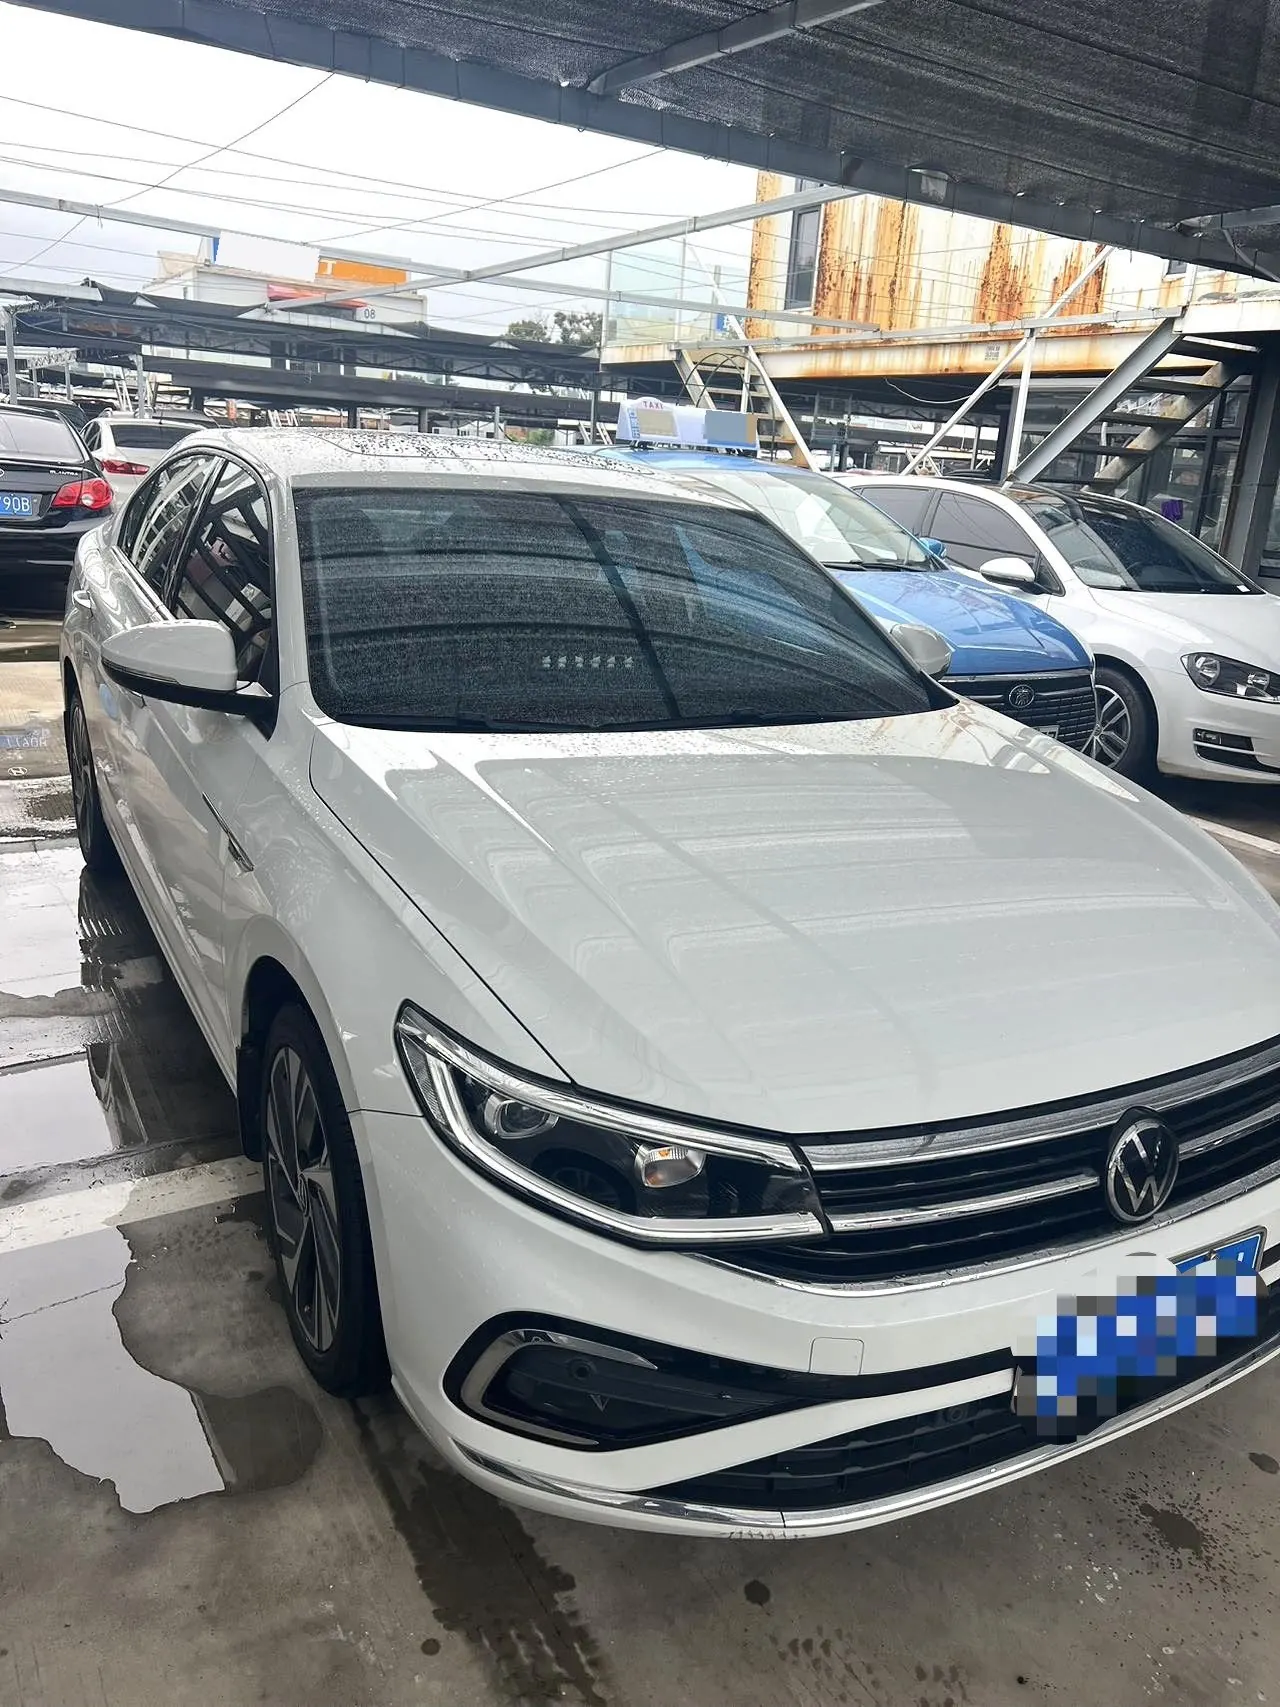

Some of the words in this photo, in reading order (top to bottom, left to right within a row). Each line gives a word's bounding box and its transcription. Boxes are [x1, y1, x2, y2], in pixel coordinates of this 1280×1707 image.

[363, 308, 376, 319] 08
[642, 400, 664, 410] TAXI
[0, 496, 30, 512] 90B
